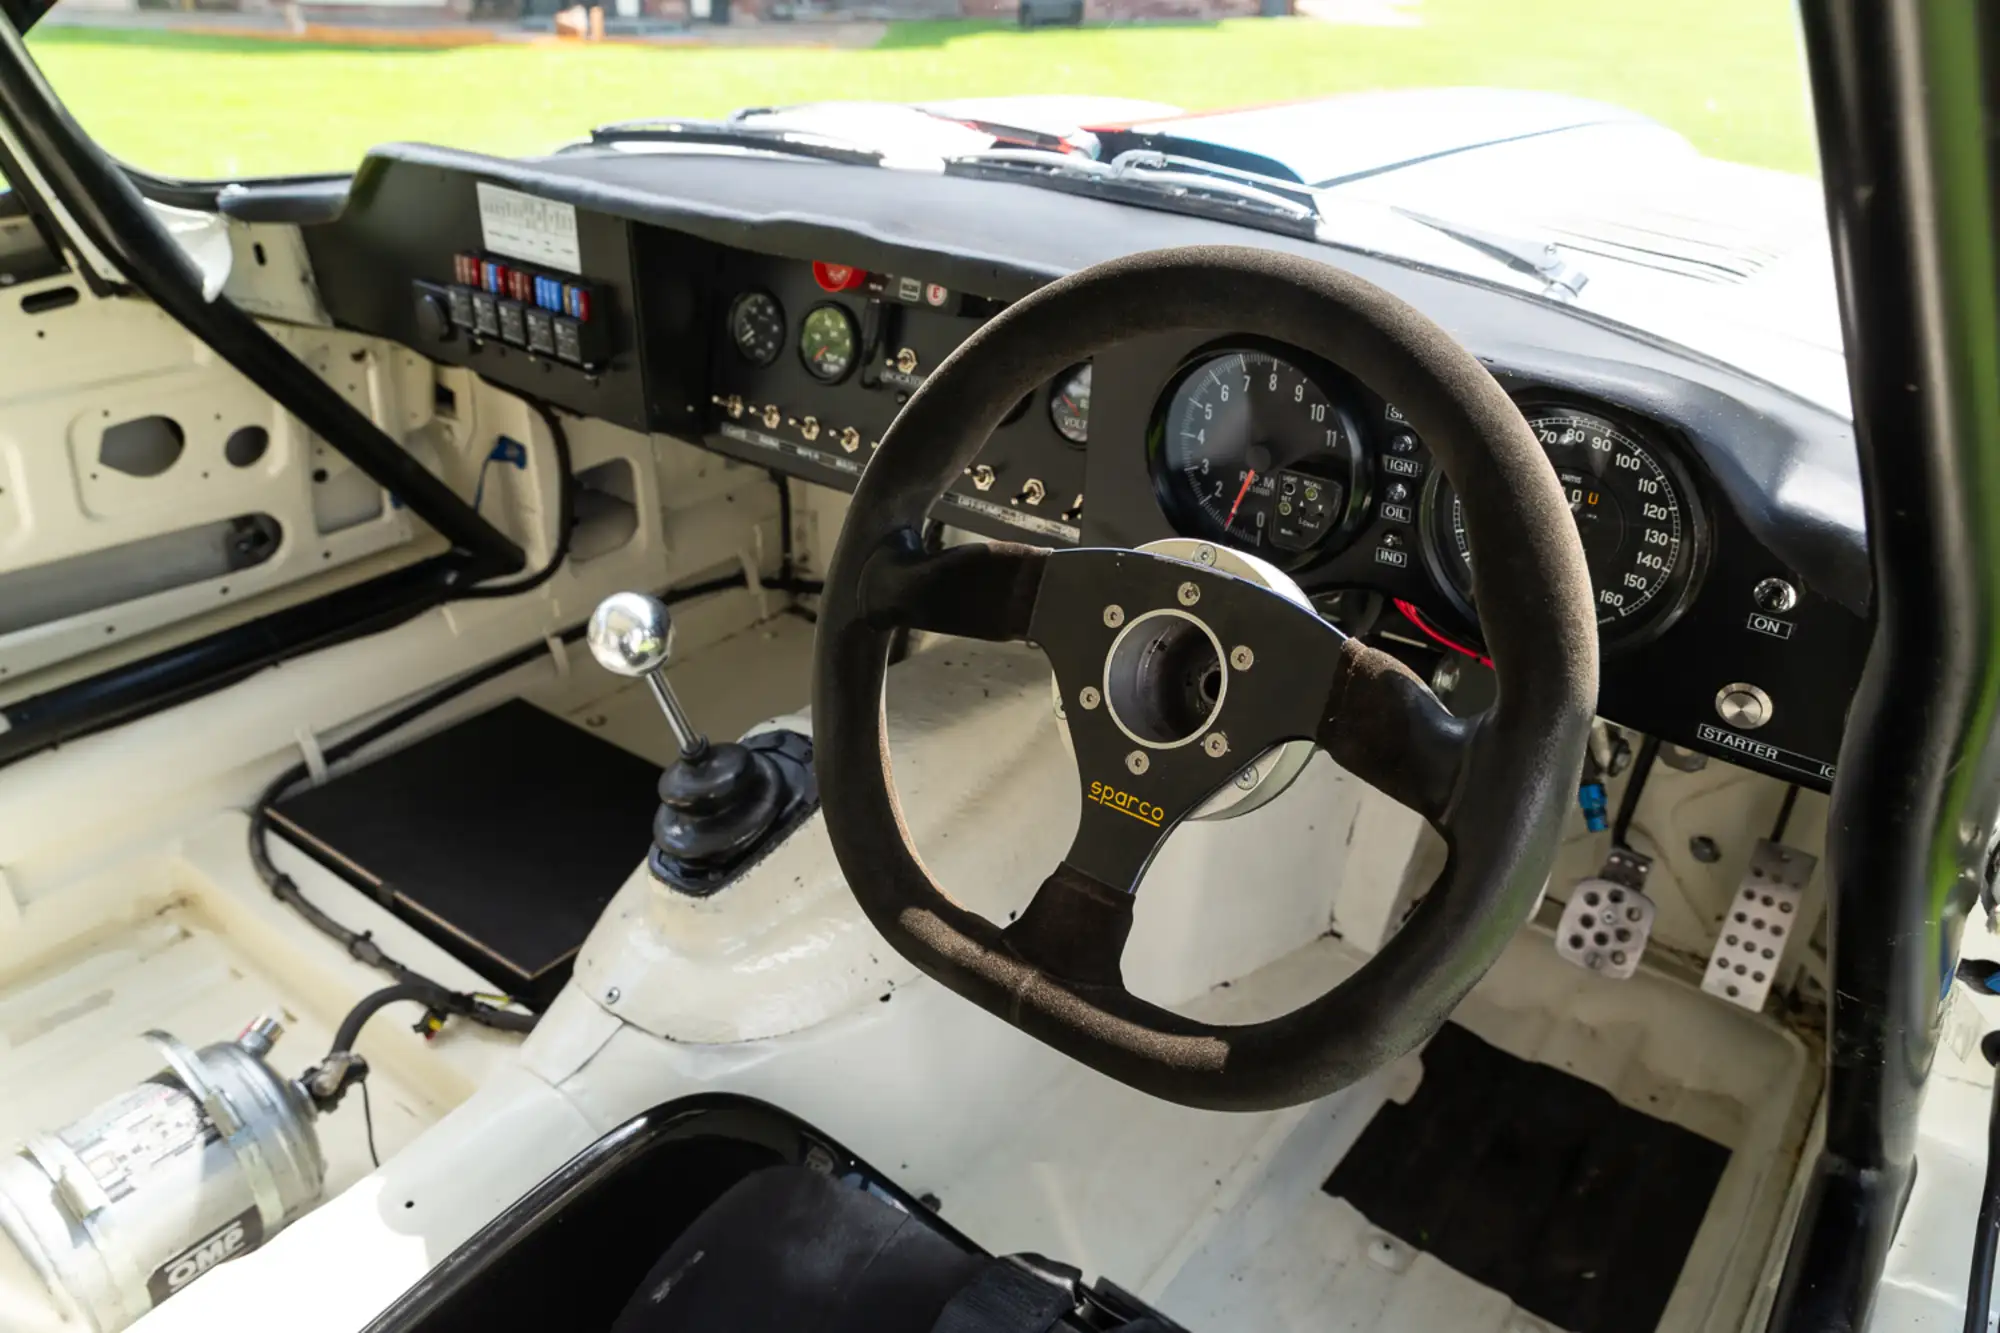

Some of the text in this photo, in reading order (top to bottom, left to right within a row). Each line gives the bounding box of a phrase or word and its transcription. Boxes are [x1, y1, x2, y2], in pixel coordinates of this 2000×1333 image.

[1243, 375, 1251, 392] 7
[1269, 373, 1277, 391] 8
[1220, 384, 1229, 402] 6
[1294, 385, 1304, 402] 9
[1204, 403, 1213, 420] 5
[1311, 404, 1325, 422] 10
[1197, 429, 1205, 444] 4
[1326, 430, 1337, 447] 11
[1539, 429, 1557, 444] 70
[1566, 428, 1585, 443] 80
[1591, 436, 1612, 452] 90
[1201, 458, 1210, 475] 3
[1390, 459, 1414, 474] IGN
[1615, 453, 1641, 471] 100
[1214, 480, 1224, 498] 2
[1637, 478, 1658, 495] 110
[1256, 511, 1265, 528] 0
[1385, 505, 1407, 521] OIL
[1643, 502, 1668, 521] 120
[1644, 528, 1669, 546] 130
[1380, 550, 1403, 565] IND
[1636, 551, 1663, 570] 140
[1623, 572, 1648, 590] 150
[1600, 589, 1624, 607] 160
[1754, 616, 1780, 633] ON
[1703, 727, 1836, 779] STARTER IG
[1090, 781, 1164, 821] sparco
[167, 1226, 244, 1286] OMP
